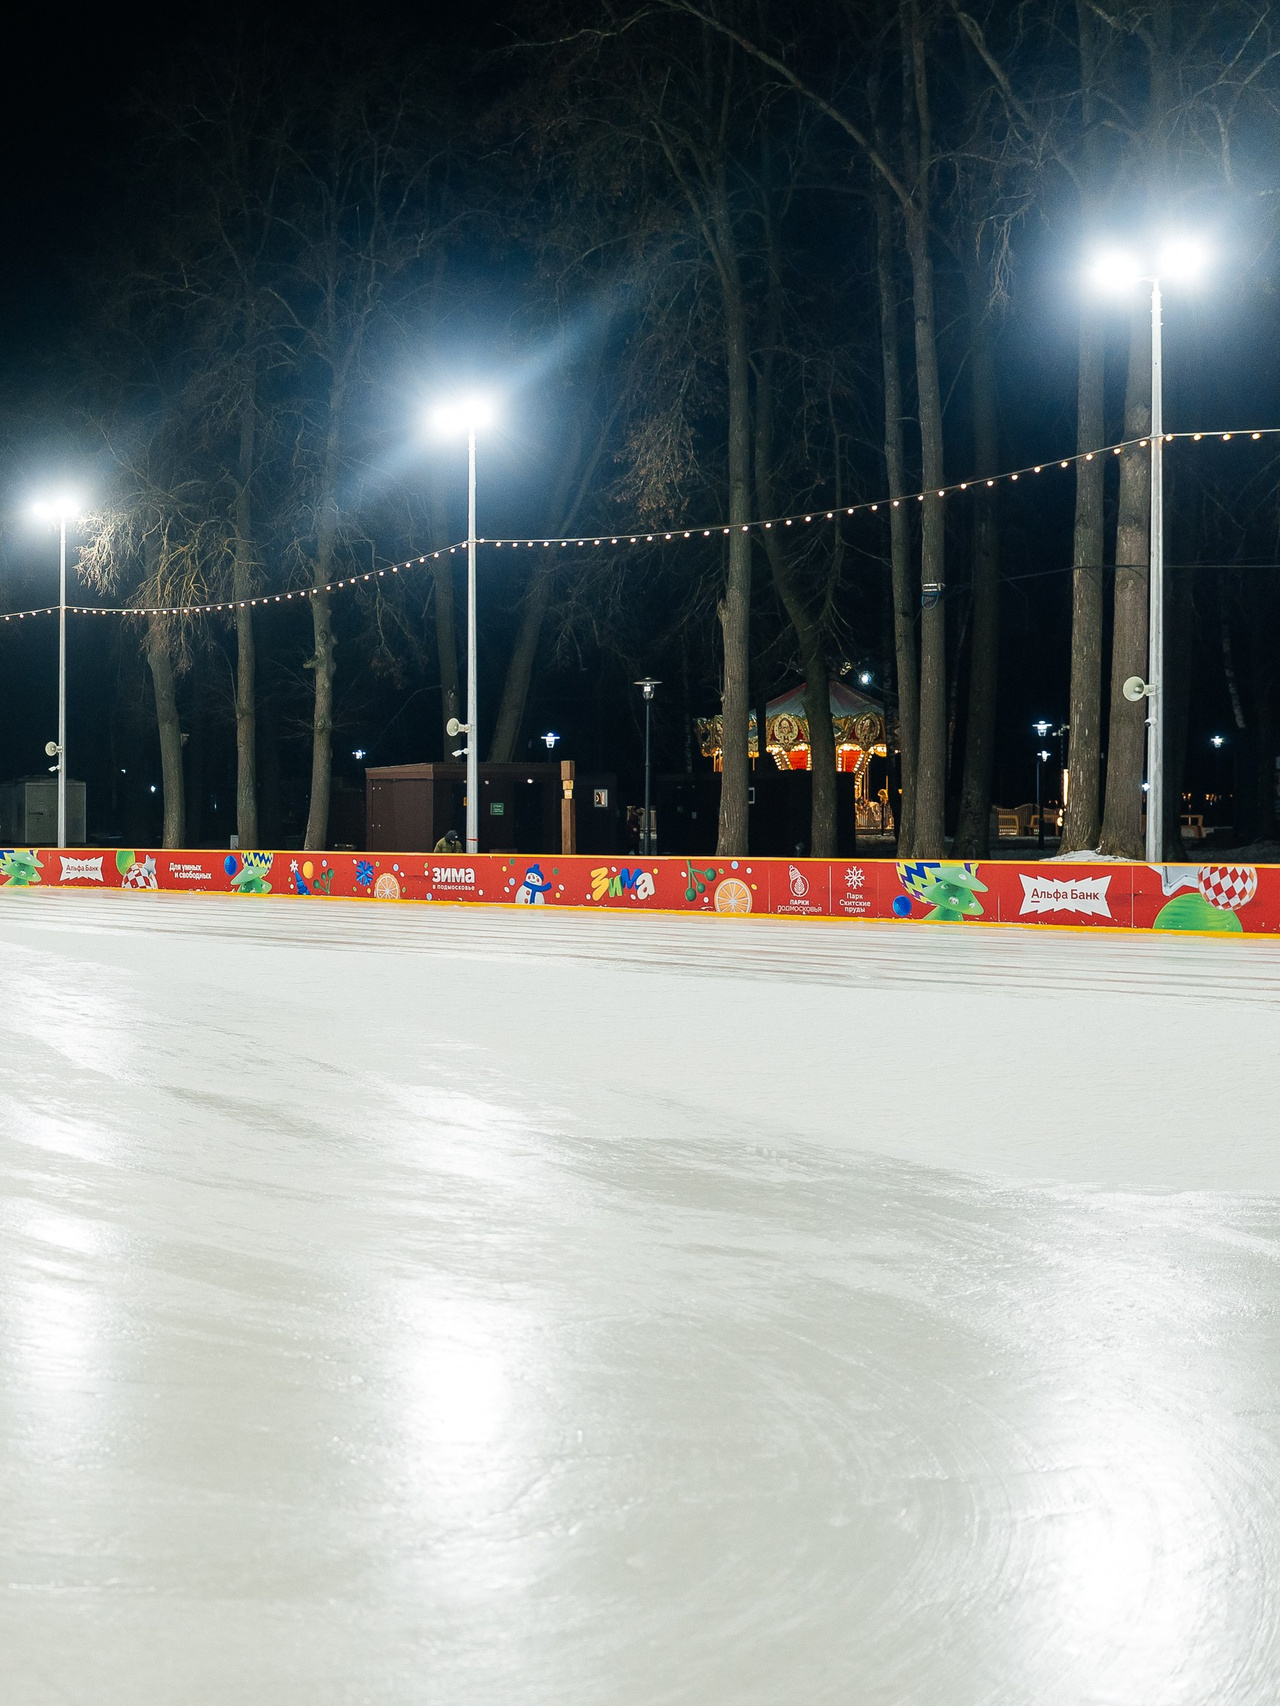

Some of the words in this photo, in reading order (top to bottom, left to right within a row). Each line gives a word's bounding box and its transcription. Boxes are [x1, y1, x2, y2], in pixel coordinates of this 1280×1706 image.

[66, 864, 84, 873] Альфа
[169, 862, 181, 871] Для
[179, 871, 212, 880] свободных
[846, 892, 864, 900] Парк
[1031, 888, 1068, 902] Альфа
[1070, 888, 1099, 900] Банк
[839, 899, 871, 907] Скитские
